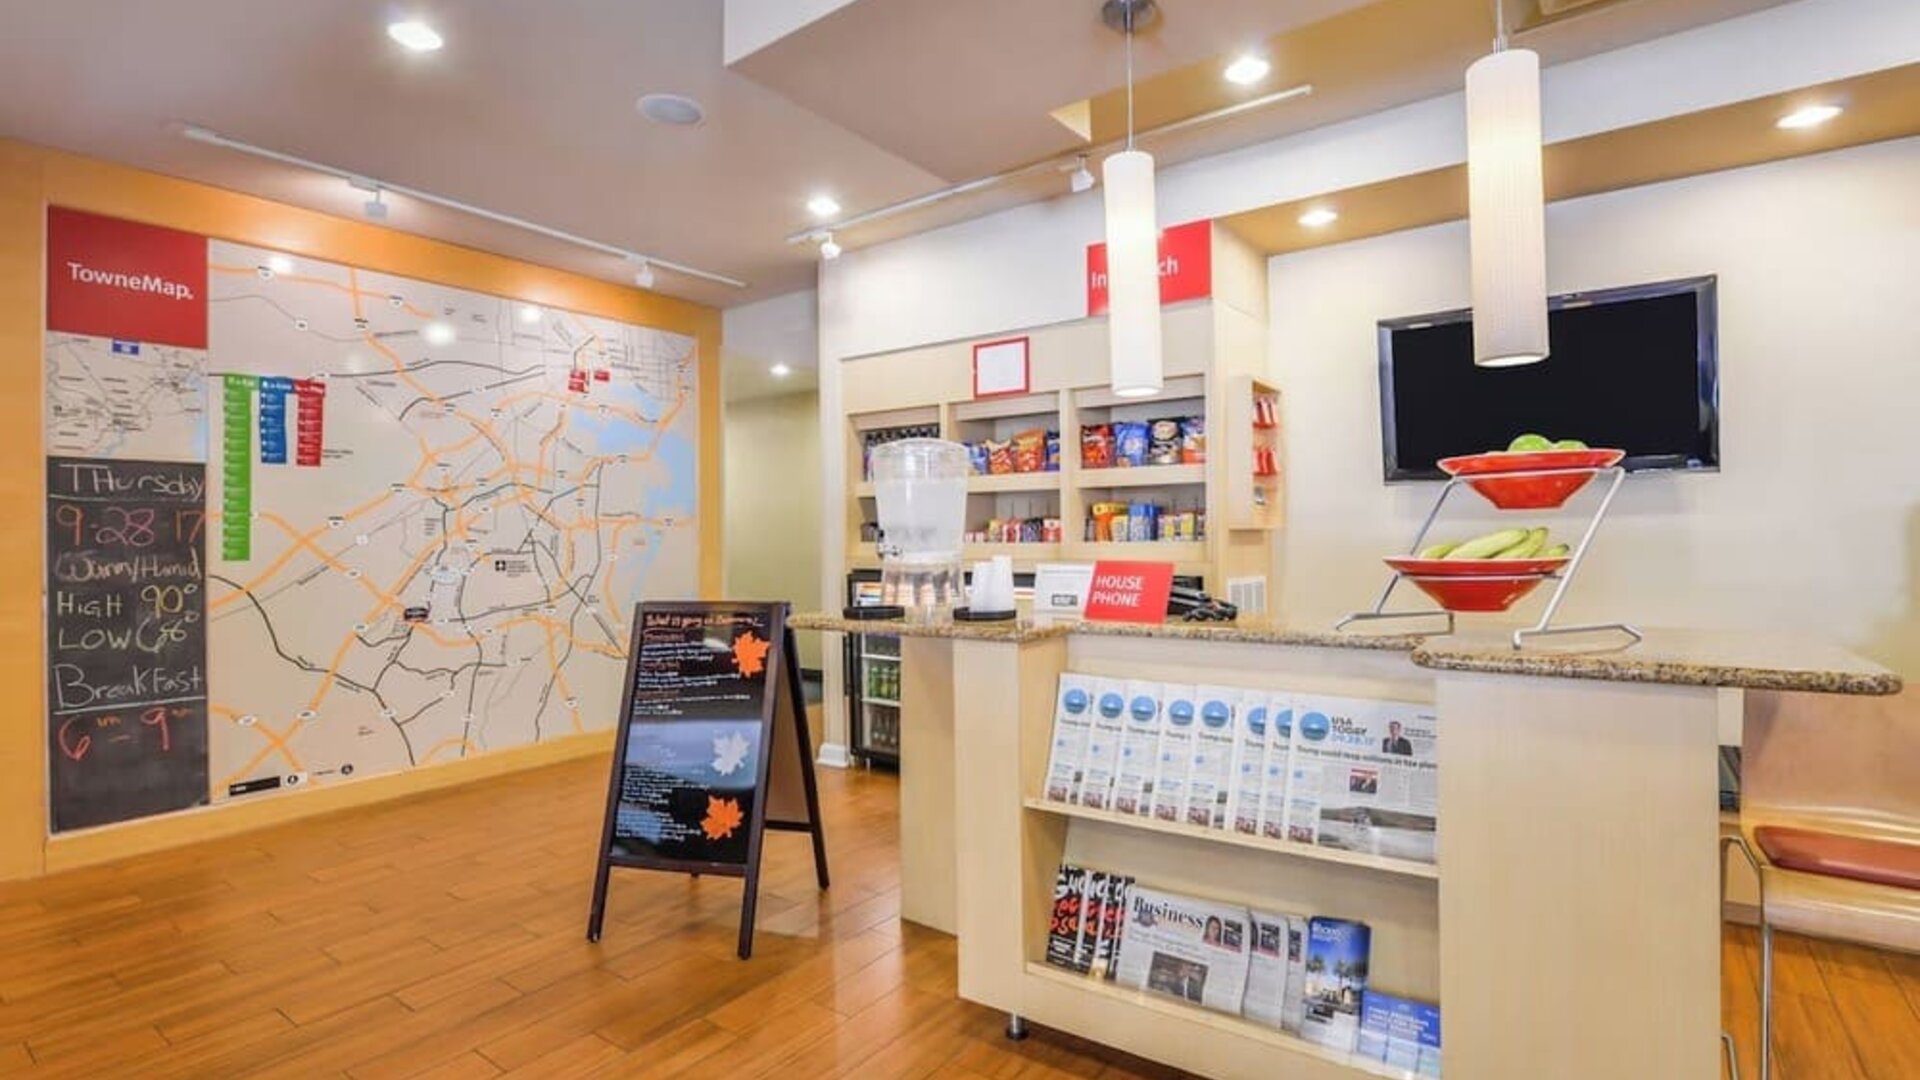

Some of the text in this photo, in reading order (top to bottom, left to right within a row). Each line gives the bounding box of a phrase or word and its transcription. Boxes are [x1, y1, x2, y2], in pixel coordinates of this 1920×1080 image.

[1096, 575, 1144, 590] HOUSE
[1092, 591, 1141, 607] PHONE
[58, 628, 132, 651] LOW
[1331, 716, 1353, 727] USA
[1331, 725, 1368, 736] TODAY
[1296, 745, 1319, 756] Trump
[1133, 895, 1205, 930] Business
